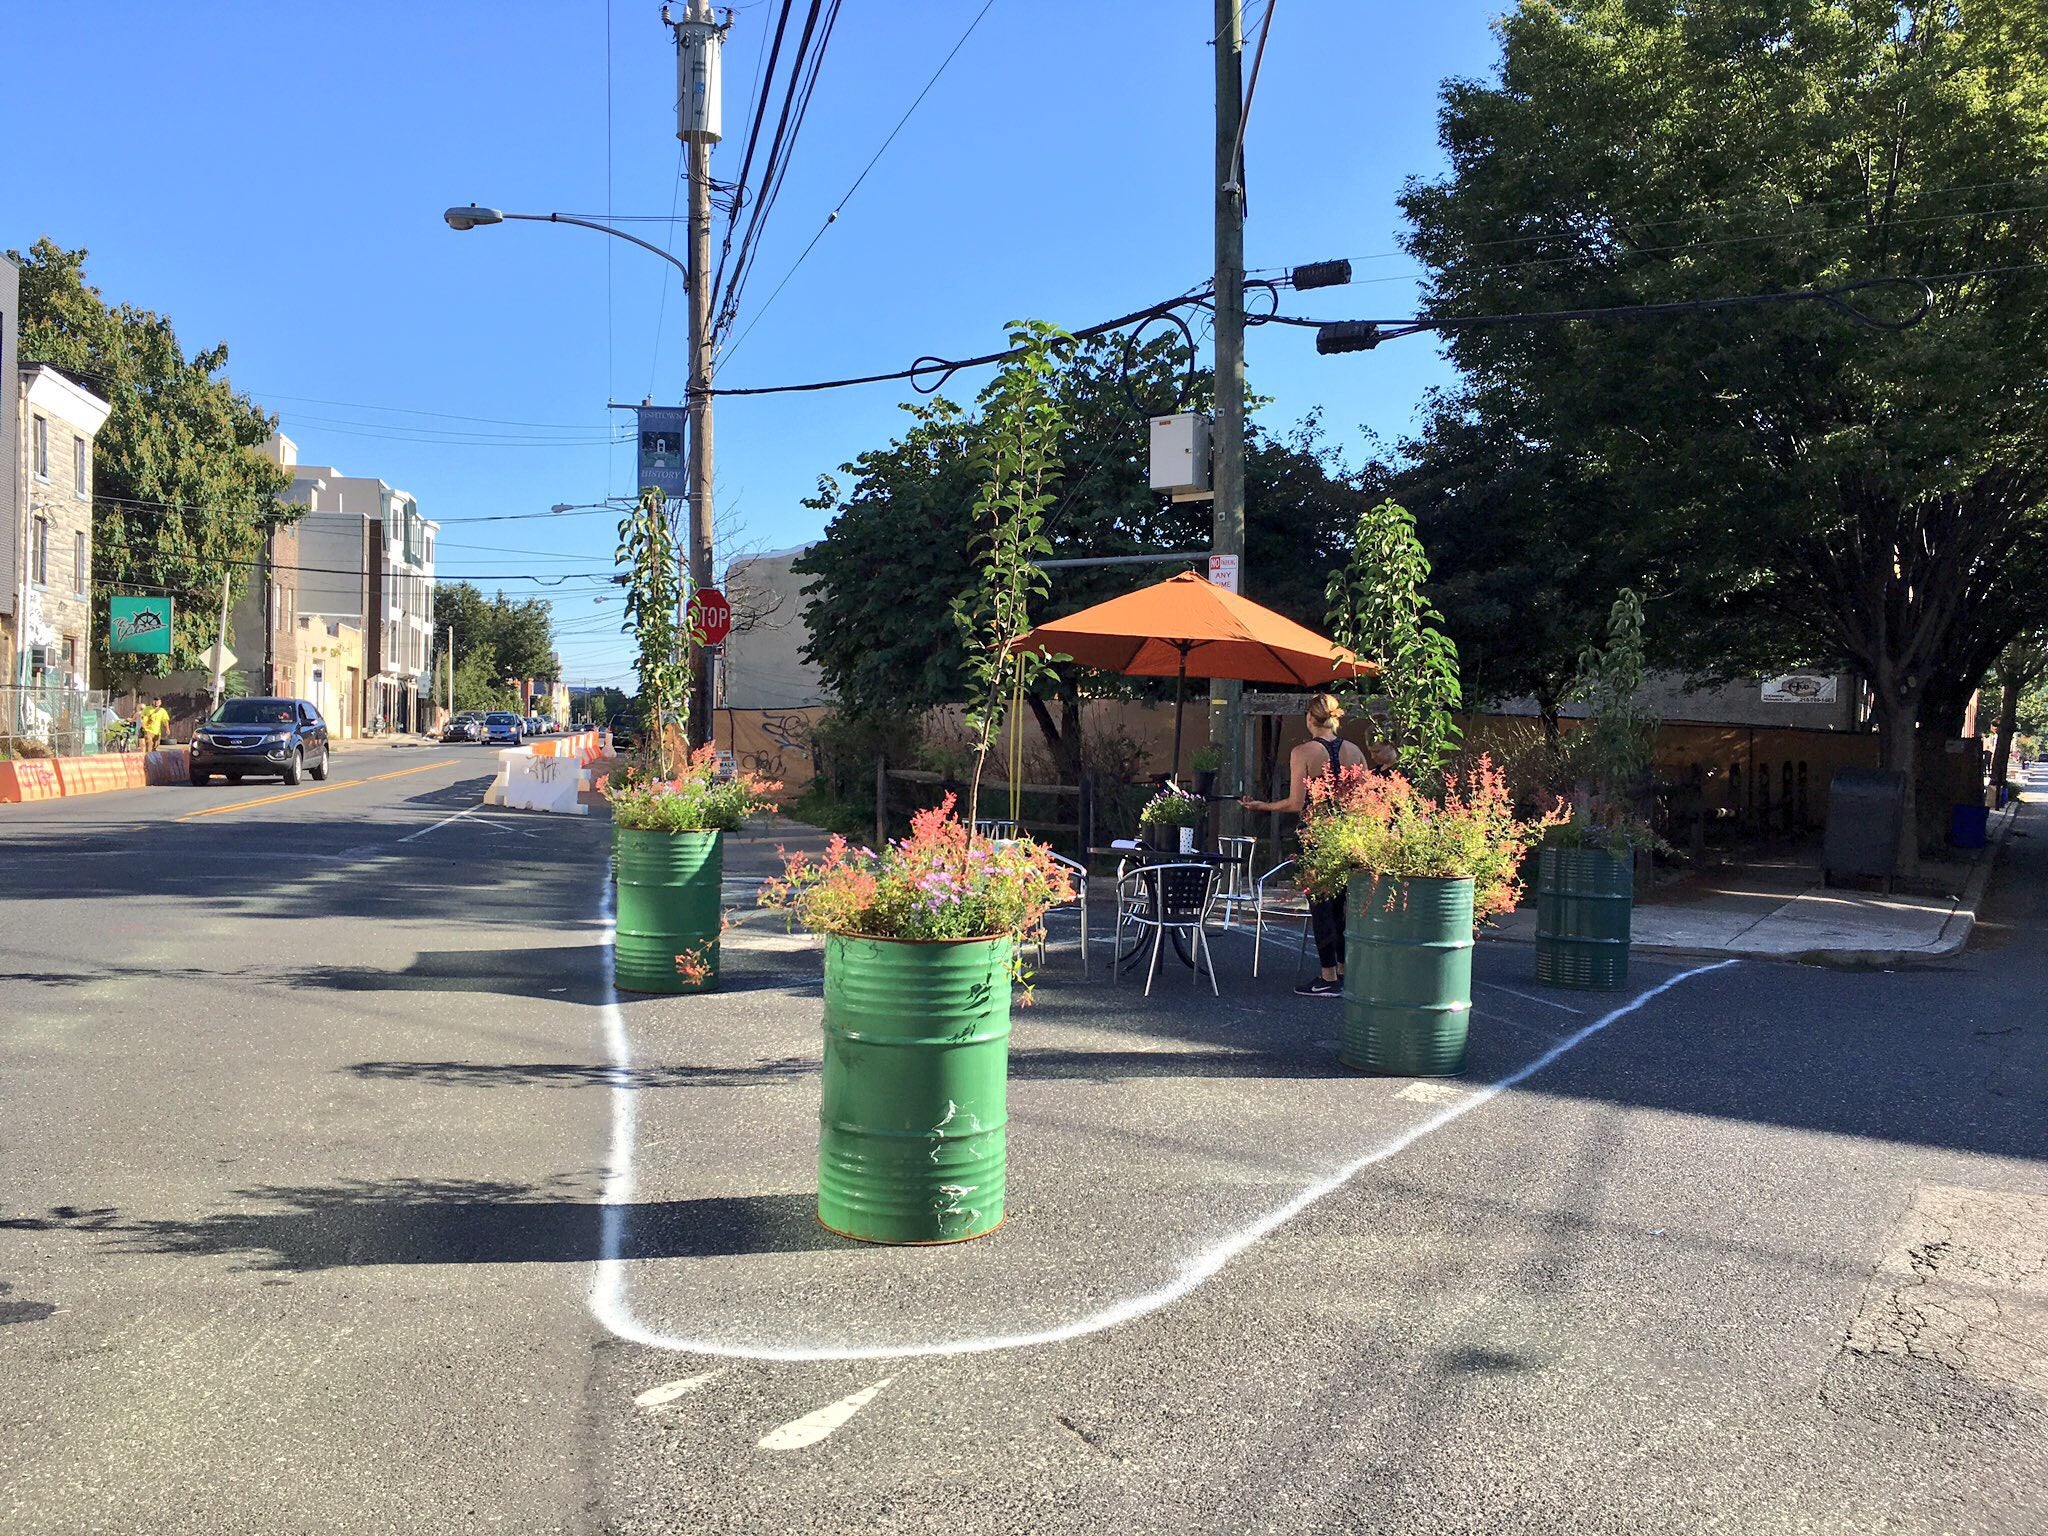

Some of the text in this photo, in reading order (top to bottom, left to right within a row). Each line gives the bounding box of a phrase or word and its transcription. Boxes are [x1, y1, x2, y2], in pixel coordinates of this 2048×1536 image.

[641, 411, 682, 419] FISHTOWN
[641, 470, 680, 479] HISTORY
[1211, 558, 1220, 568] NO
[692, 606, 728, 628] STOP
